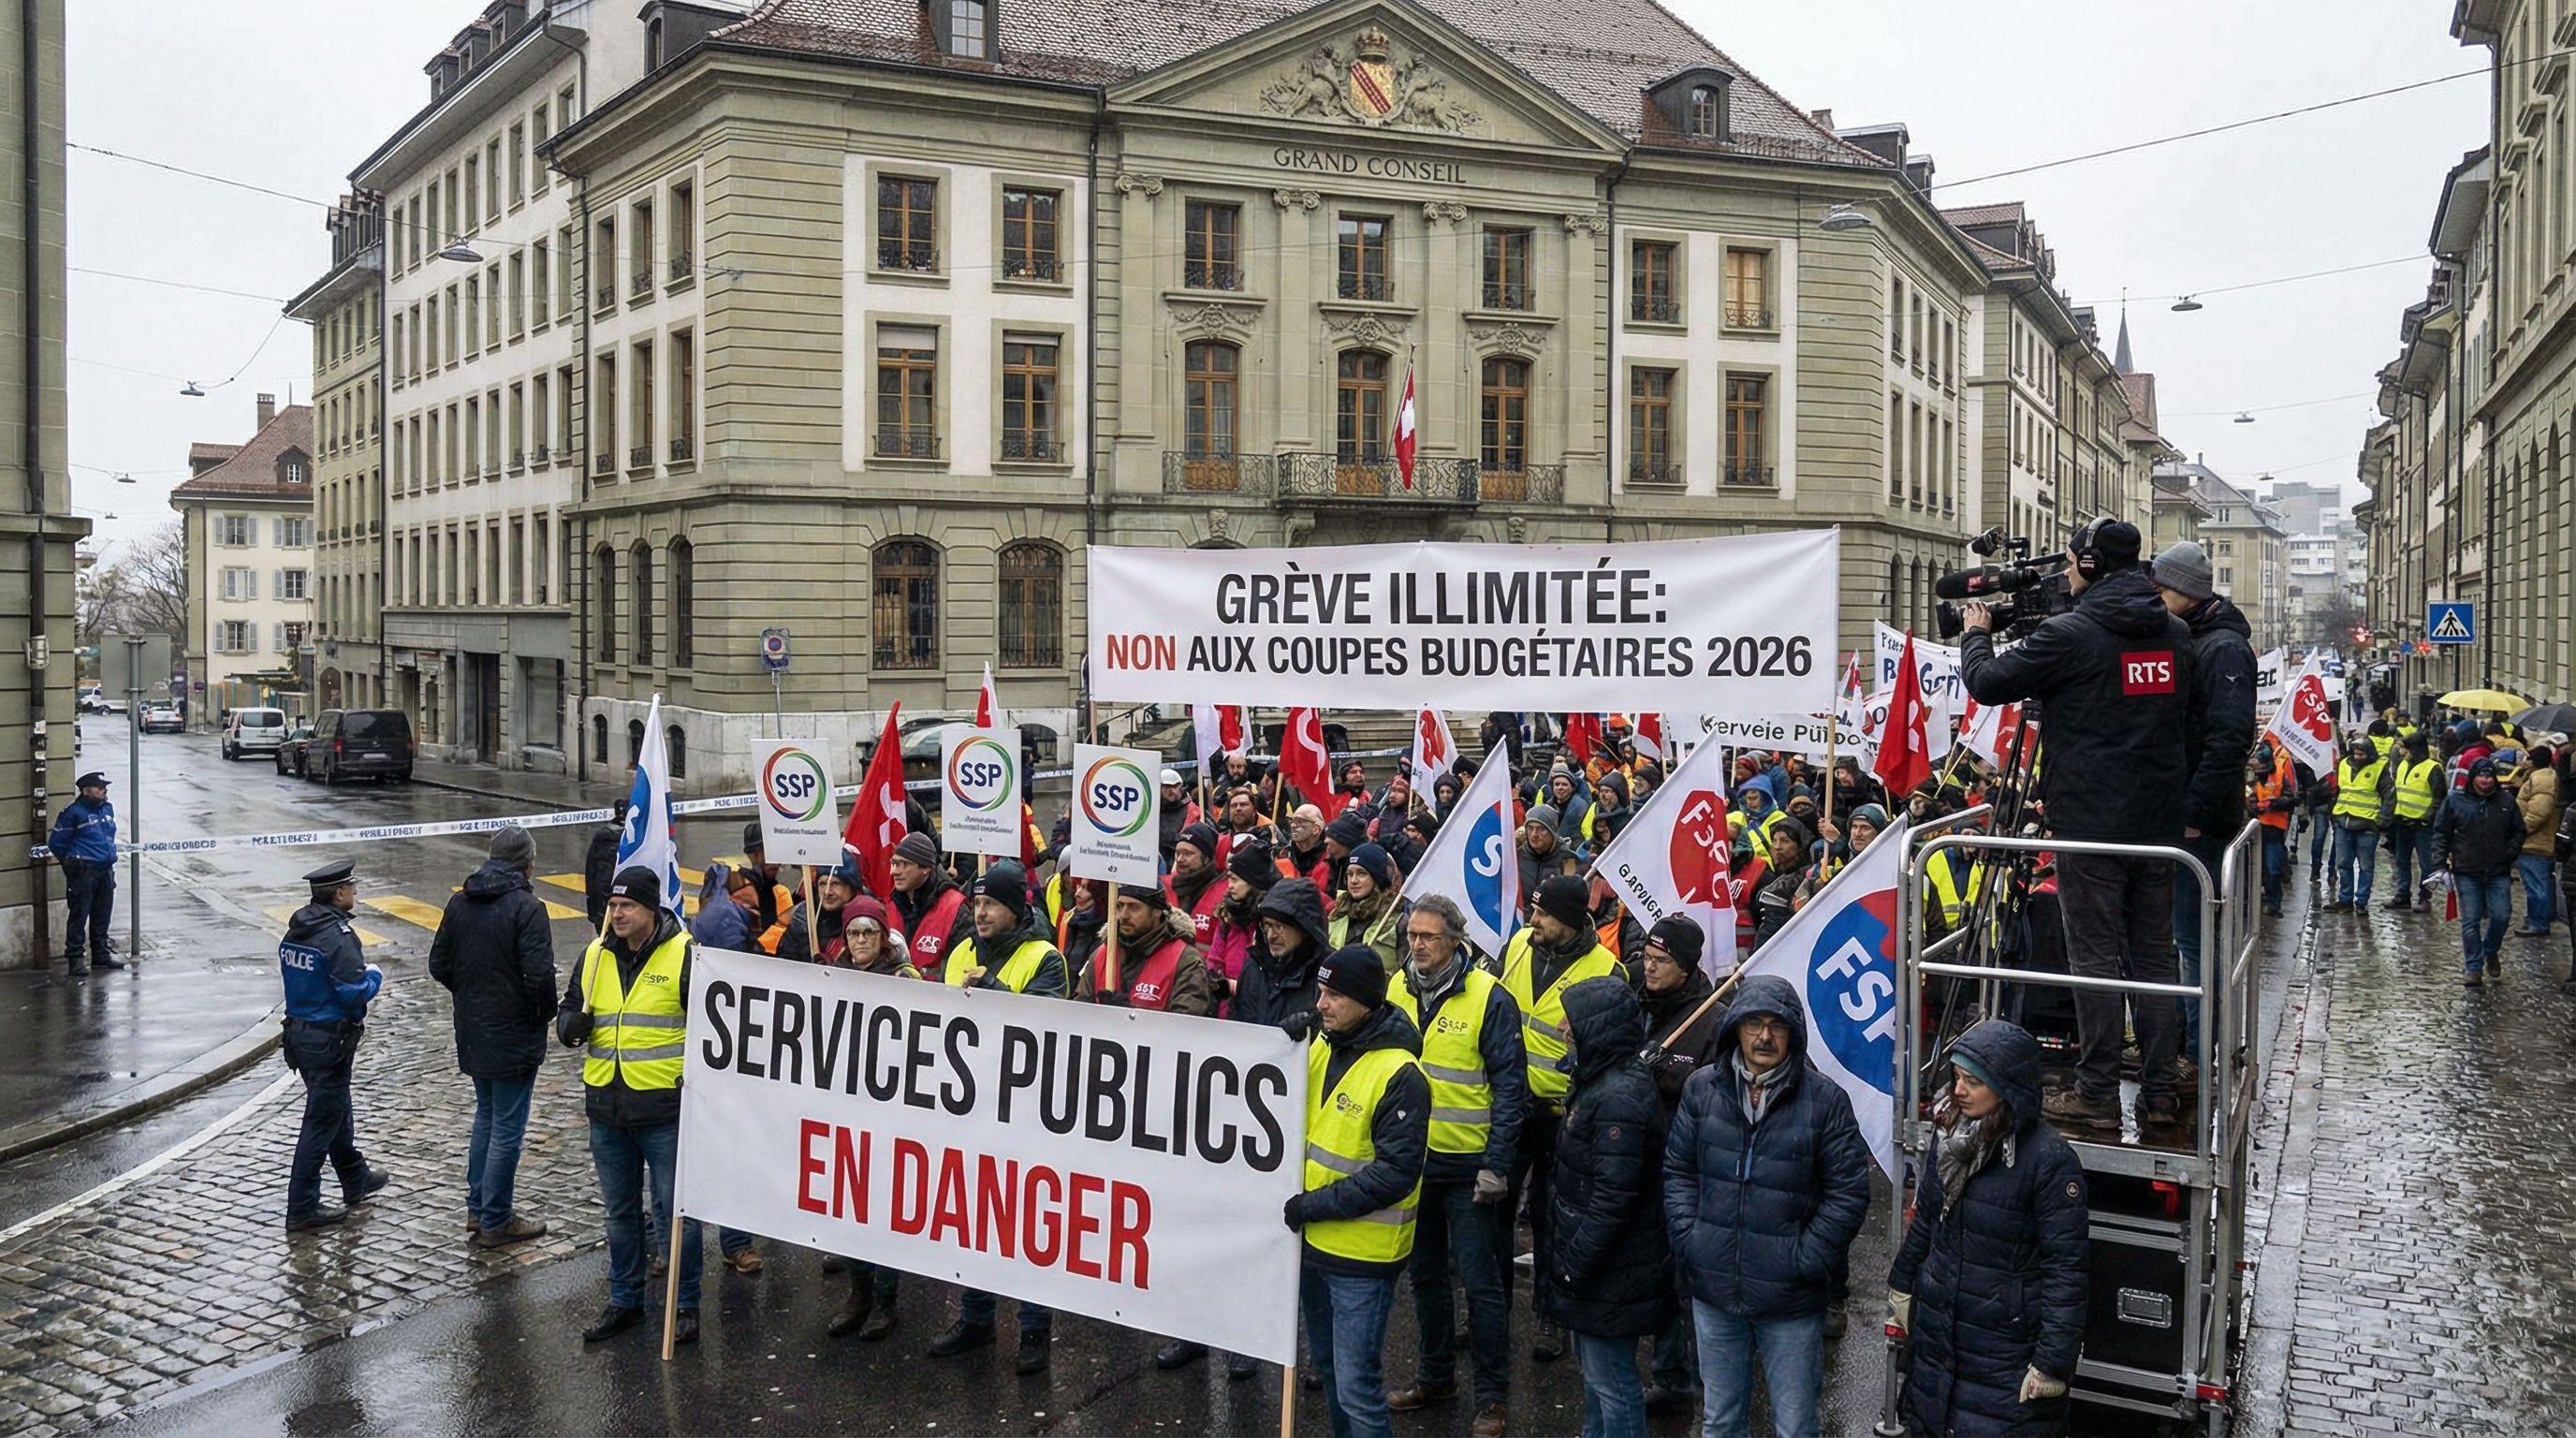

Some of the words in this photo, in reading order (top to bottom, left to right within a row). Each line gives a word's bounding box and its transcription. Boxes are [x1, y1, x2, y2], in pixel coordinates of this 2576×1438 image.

[1274, 147, 1358, 173] GRAND
[1367, 156, 1467, 183] CONSEIL
[1216, 561, 1371, 624] GRÈVE
[1389, 556, 1666, 624] ILLIMITÉE:
[1106, 634, 1176, 671] NON
[1186, 636, 1256, 673] AUX
[1267, 636, 1409, 676] COUPES
[1421, 627, 1693, 678] BUDGÉTAIRES
[1707, 635, 1812, 677] 2026
[2128, 661, 2171, 684] RTS
[775, 773, 815, 799] SSP
[960, 762, 1003, 787] SSP
[1093, 783, 1139, 812] SSP
[702, 979, 980, 1116] SERVICES
[997, 1024, 1288, 1173] PUBLICS
[797, 1118, 871, 1225] EN
[889, 1137, 1152, 1291] DANGER
